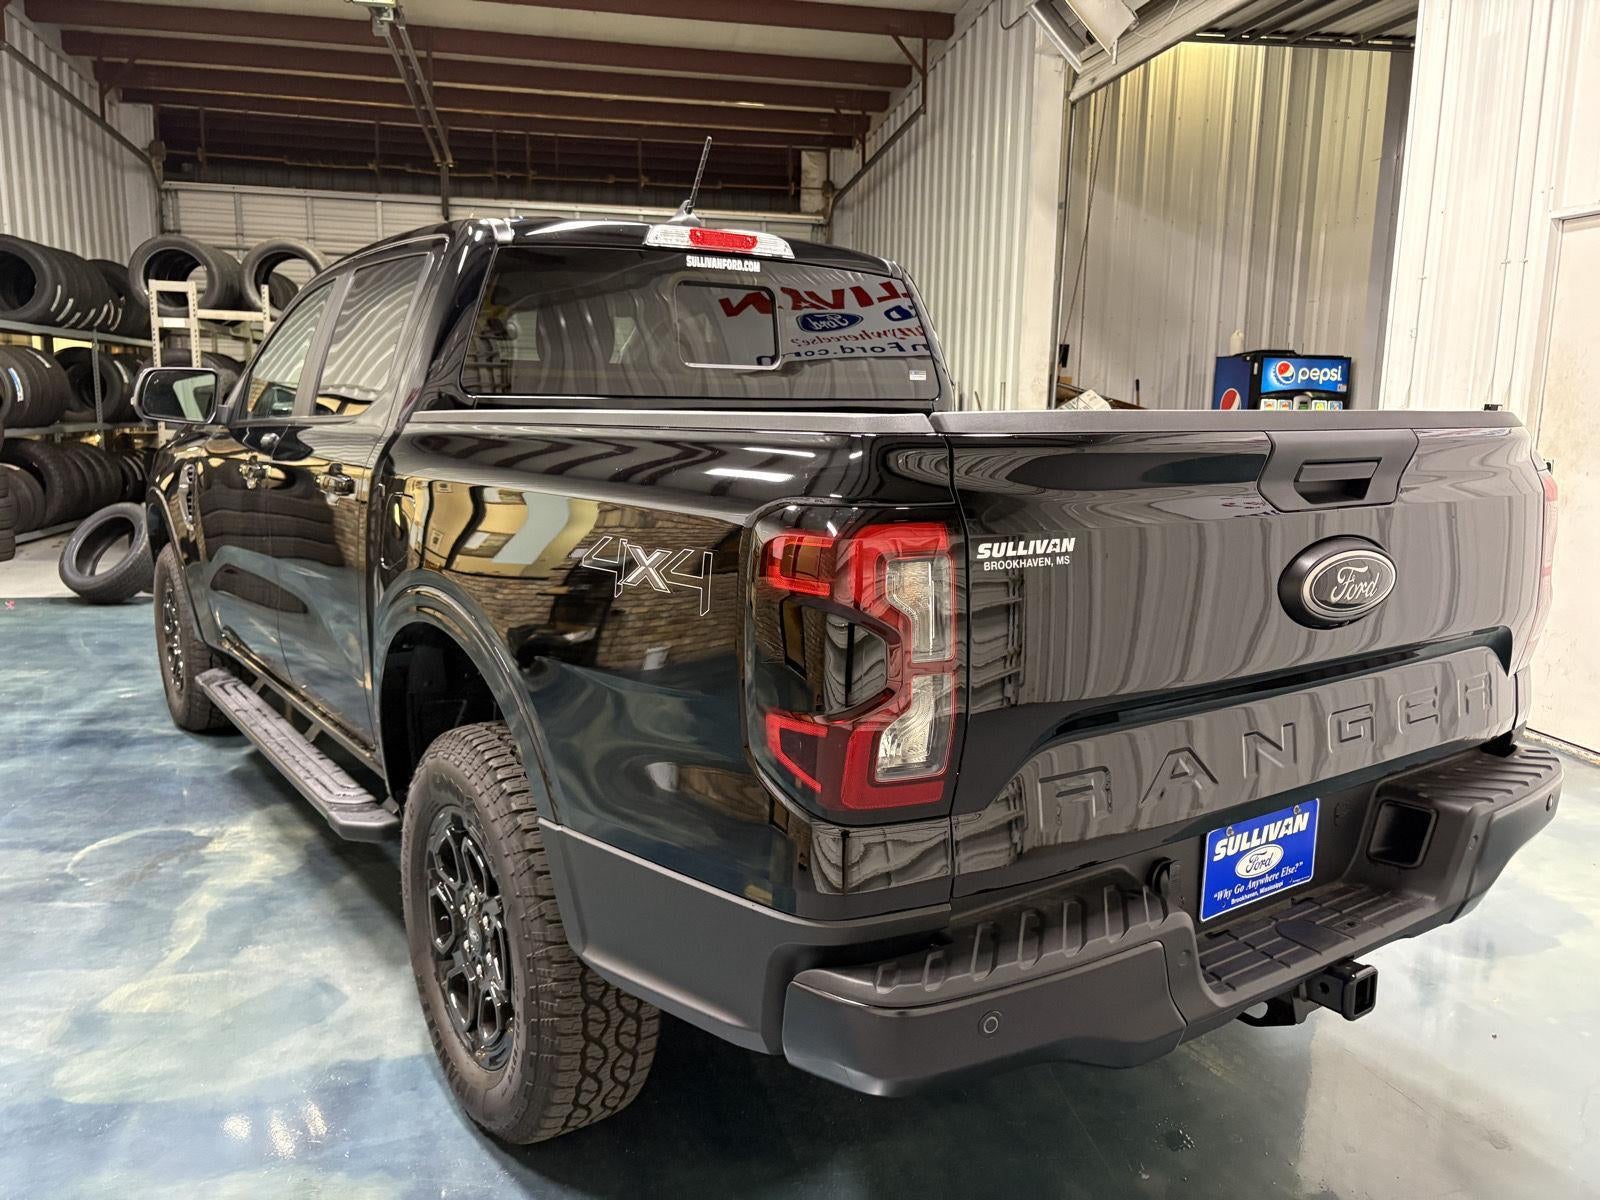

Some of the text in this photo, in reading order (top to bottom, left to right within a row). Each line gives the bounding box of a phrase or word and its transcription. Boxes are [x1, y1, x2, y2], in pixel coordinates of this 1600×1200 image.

[686, 255, 761, 273] SULLIVANFORD.COM
[1298, 365, 1342, 384] pepsi
[976, 537, 1076, 559] SULLIVAN
[983, 555, 1070, 571] BROOKHAVEN, MS
[1330, 565, 1380, 604] Ford
[1038, 672, 1493, 831] RANGER
[1213, 812, 1310, 862] SULLIVAN
[1245, 850, 1274, 874] Ford
[1234, 883, 1244, 894] Go
[1246, 871, 1280, 890] Anywhere
